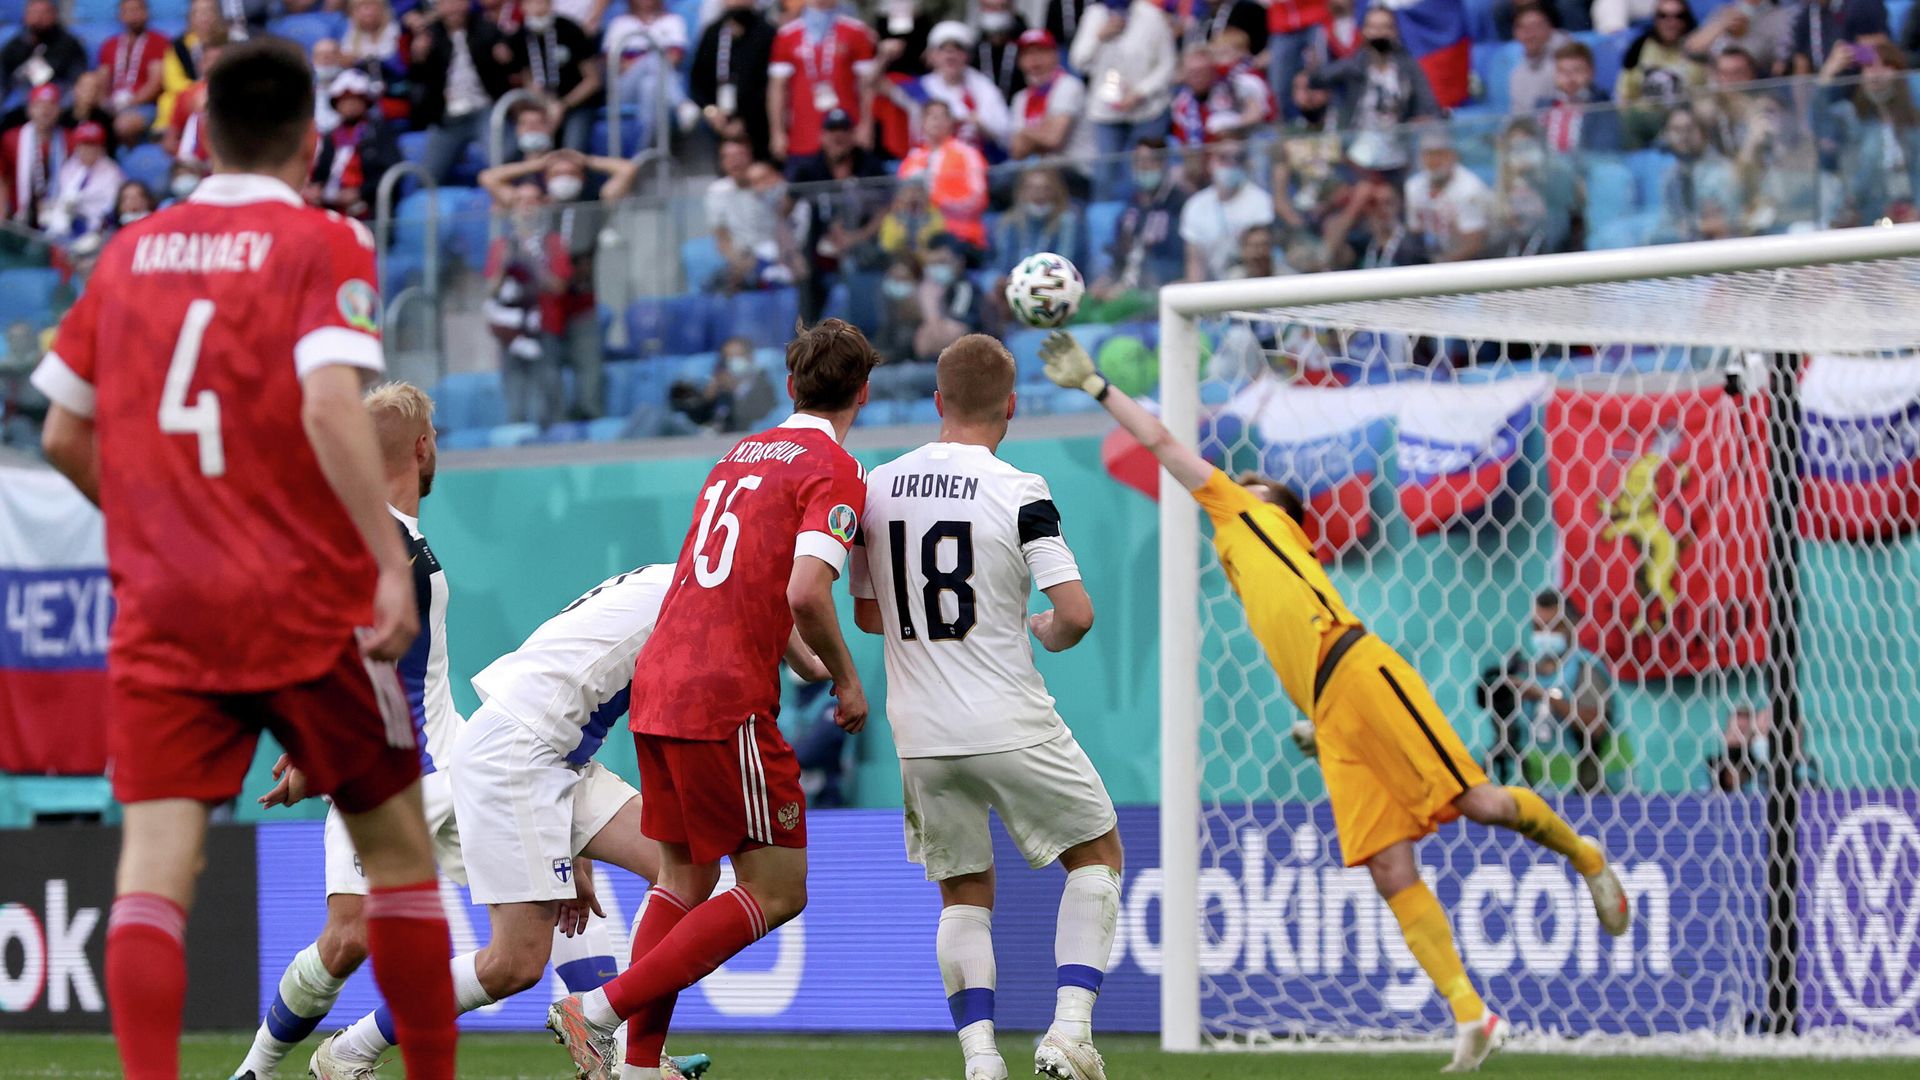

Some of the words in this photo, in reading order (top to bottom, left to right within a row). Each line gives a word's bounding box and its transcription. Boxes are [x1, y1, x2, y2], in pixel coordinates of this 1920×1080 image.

[131, 230, 273, 275] KARAVAEV
[158, 298, 226, 479] 4
[693, 474, 763, 589] 15
[891, 473, 979, 500] URONEN
[888, 519, 977, 642] 18
[1085, 822, 1671, 1012] ookingcom
